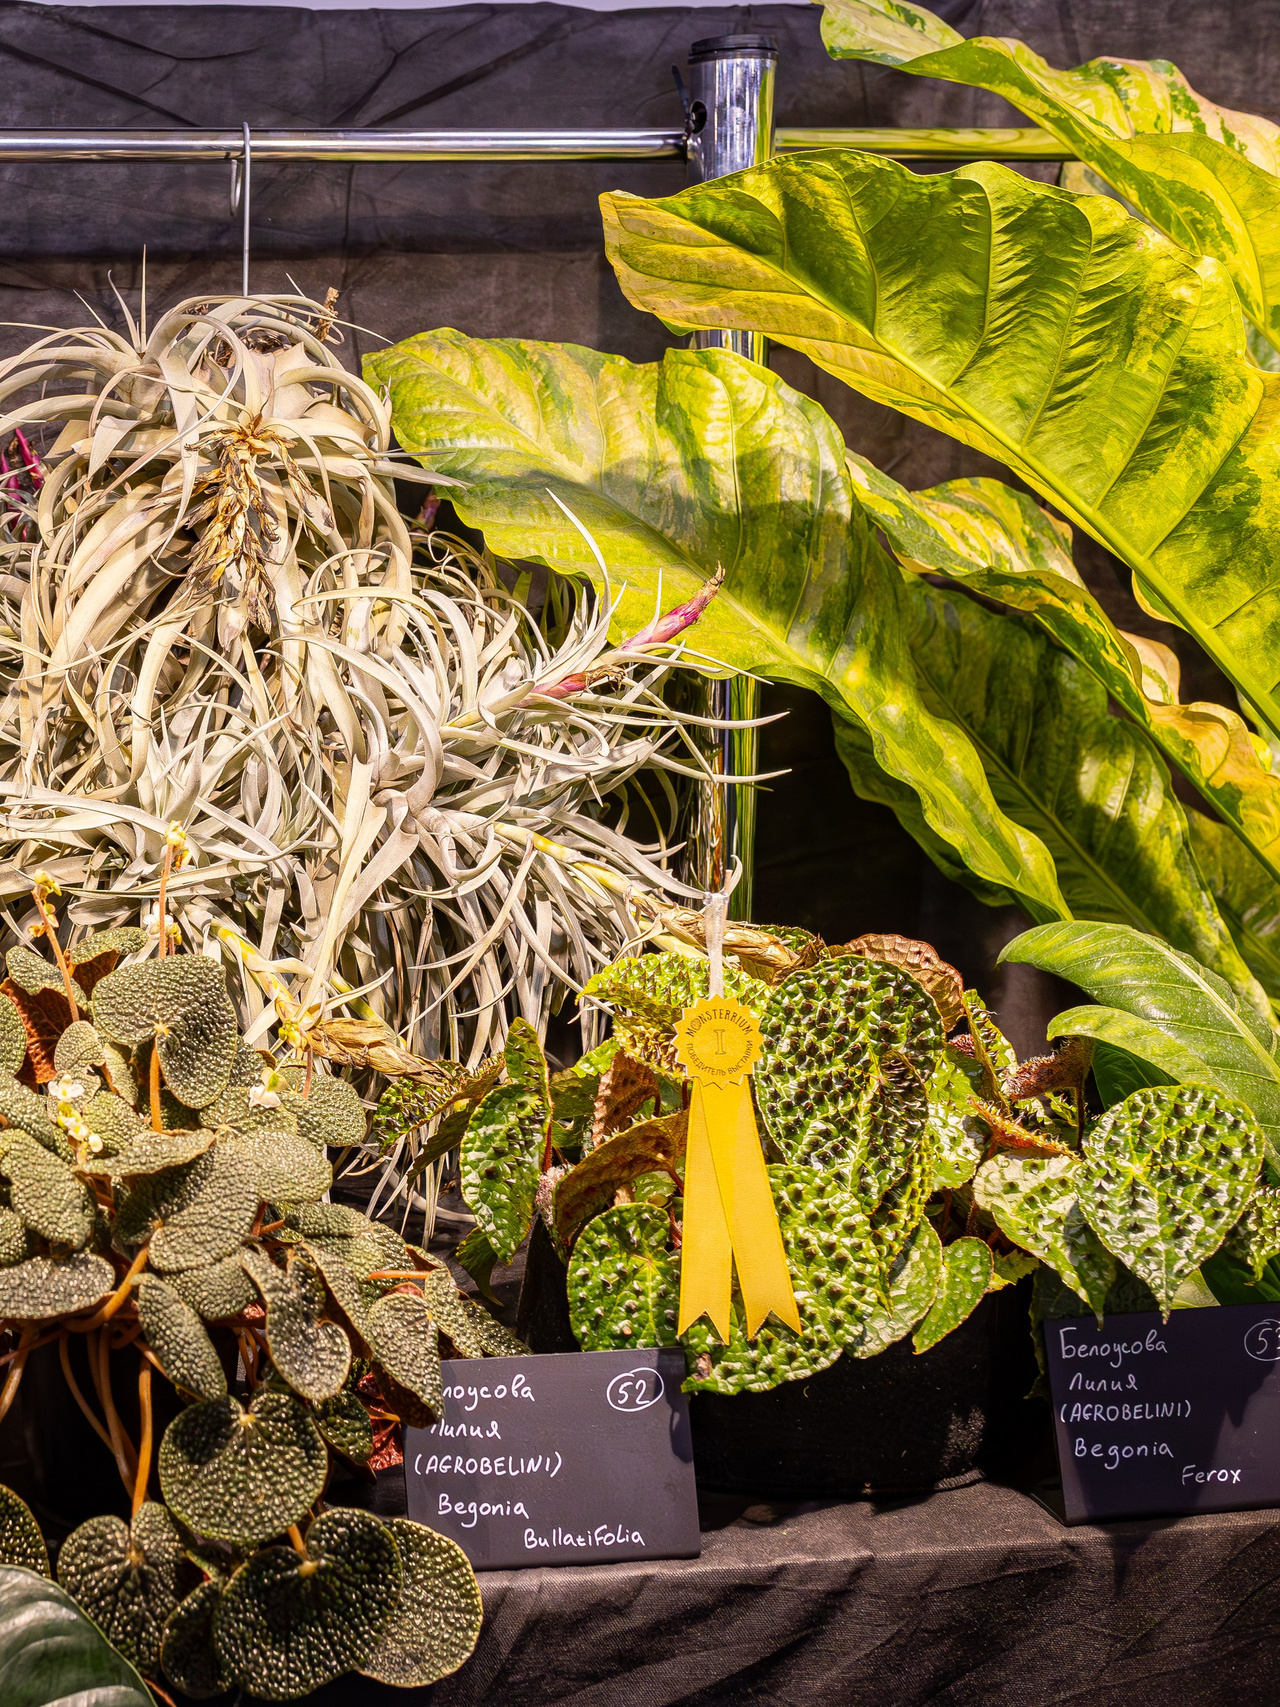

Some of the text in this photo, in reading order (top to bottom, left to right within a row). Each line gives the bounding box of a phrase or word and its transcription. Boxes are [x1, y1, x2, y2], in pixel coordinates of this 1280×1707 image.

[685, 1008, 754, 1038] MONSTERRIUM
[686, 1040, 754, 1076] ПОБЕДИТЕЛЬ ВЫСТАВКИ
[1059, 1327, 1168, 1369] Белоусова
[441, 1373, 536, 1412] лоусова
[1069, 1372, 1138, 1392] Лилия
[1060, 1400, 1192, 1423] (AGROBELINI)
[414, 1451, 563, 1478] (AGROBELINI)
[1074, 1437, 1174, 1470] Begonia
[1181, 1464, 1242, 1486] Ferox
[437, 1493, 530, 1528] Begonia
